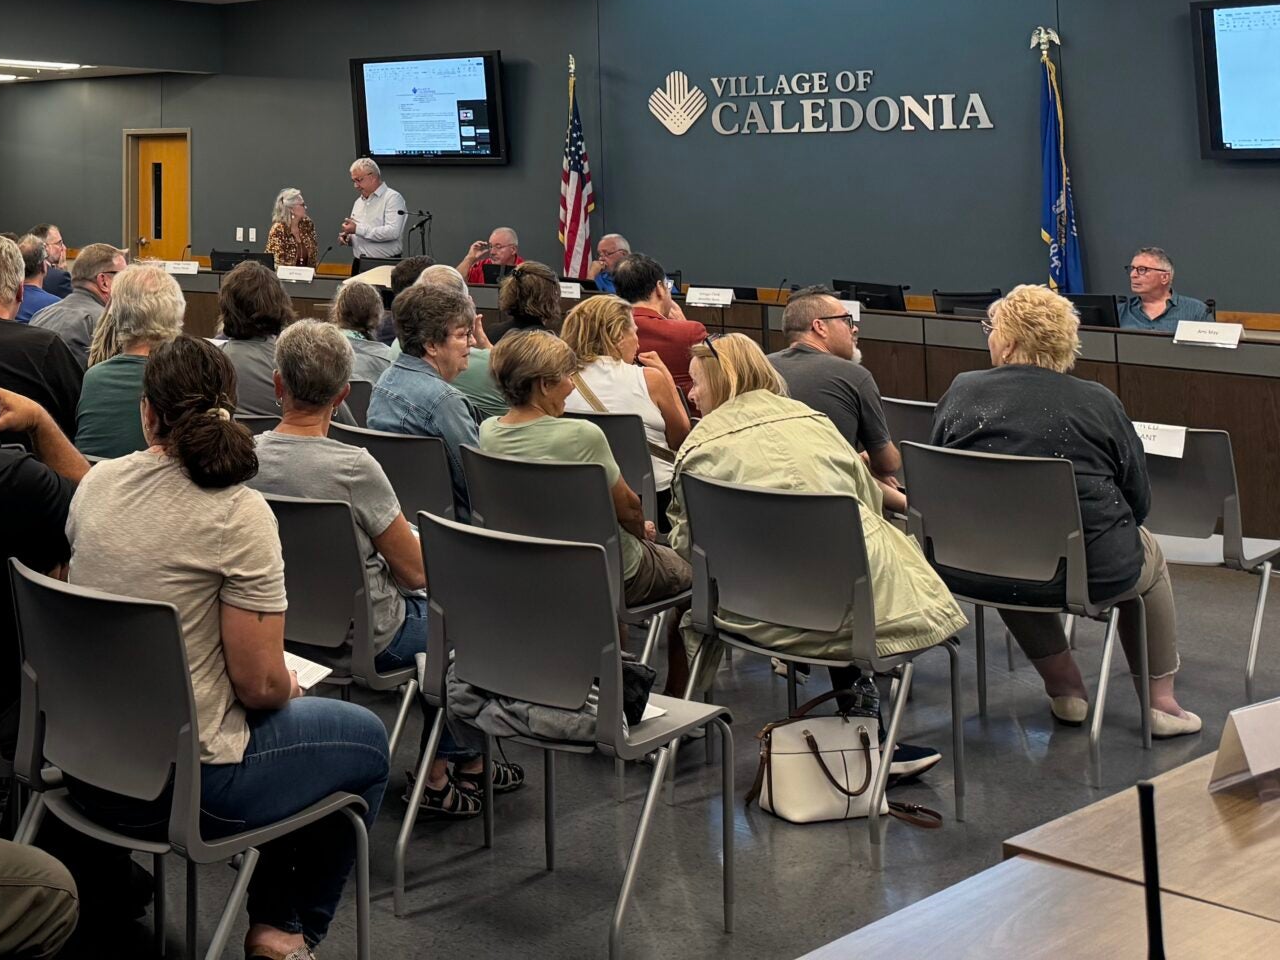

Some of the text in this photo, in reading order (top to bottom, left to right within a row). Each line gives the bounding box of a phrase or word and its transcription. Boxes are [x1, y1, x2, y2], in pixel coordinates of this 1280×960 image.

[710, 69, 874, 97] VILLAGE OF
[711, 93, 994, 136] CALEDONIA
